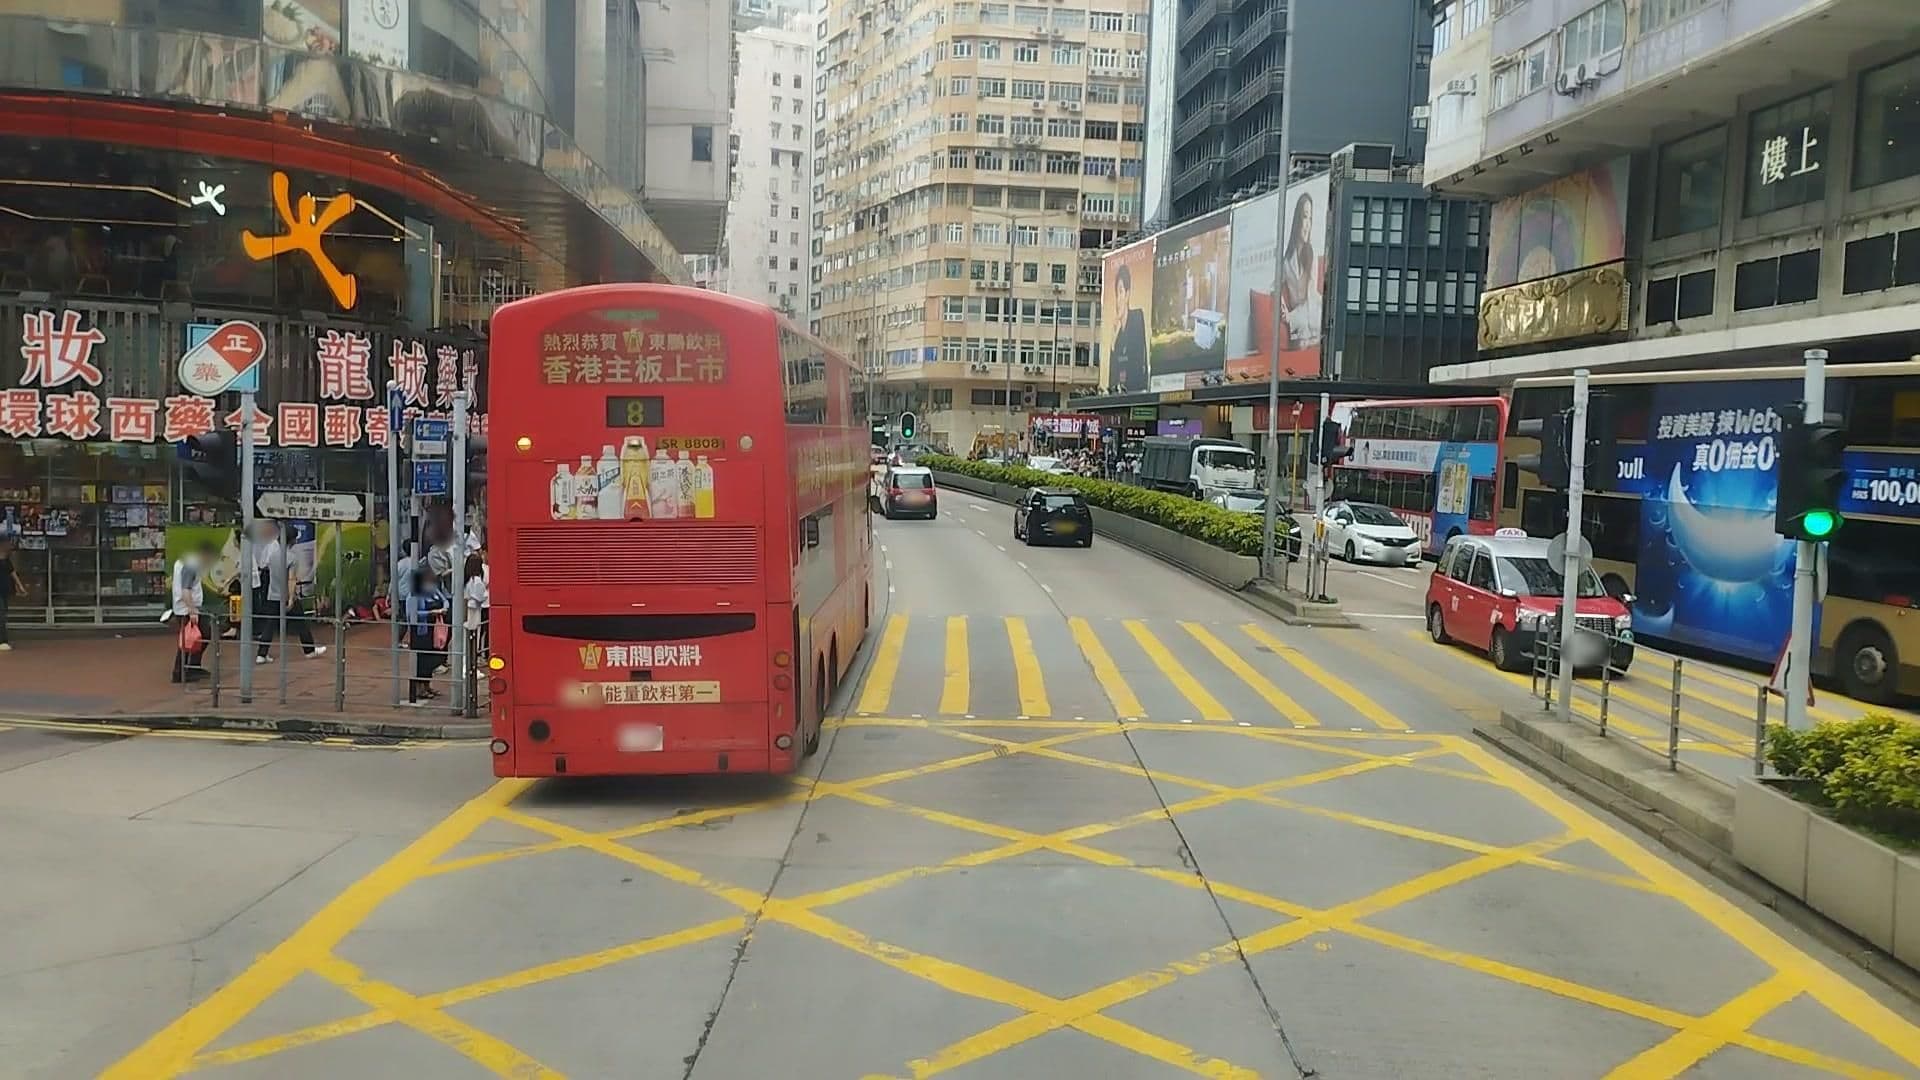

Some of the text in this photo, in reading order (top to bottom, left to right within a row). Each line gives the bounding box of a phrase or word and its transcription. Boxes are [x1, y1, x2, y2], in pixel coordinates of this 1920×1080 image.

[1760, 127, 1820, 186] 樓上
[20, 309, 106, 388] 妝
[222, 333, 253, 353] 正
[543, 332, 721, 351] 熱烈恭賀 東鵬飲料
[543, 354, 726, 385] 香港主板上市
[626, 400, 645, 426] 8
[1657, 411, 1715, 439] 投資美股
[662, 438, 679, 449] SR
[1870, 479, 1920, 506] 100,0
[605, 644, 702, 668] 東鵬飲料
[579, 683, 714, 702] 能量飲料第一
